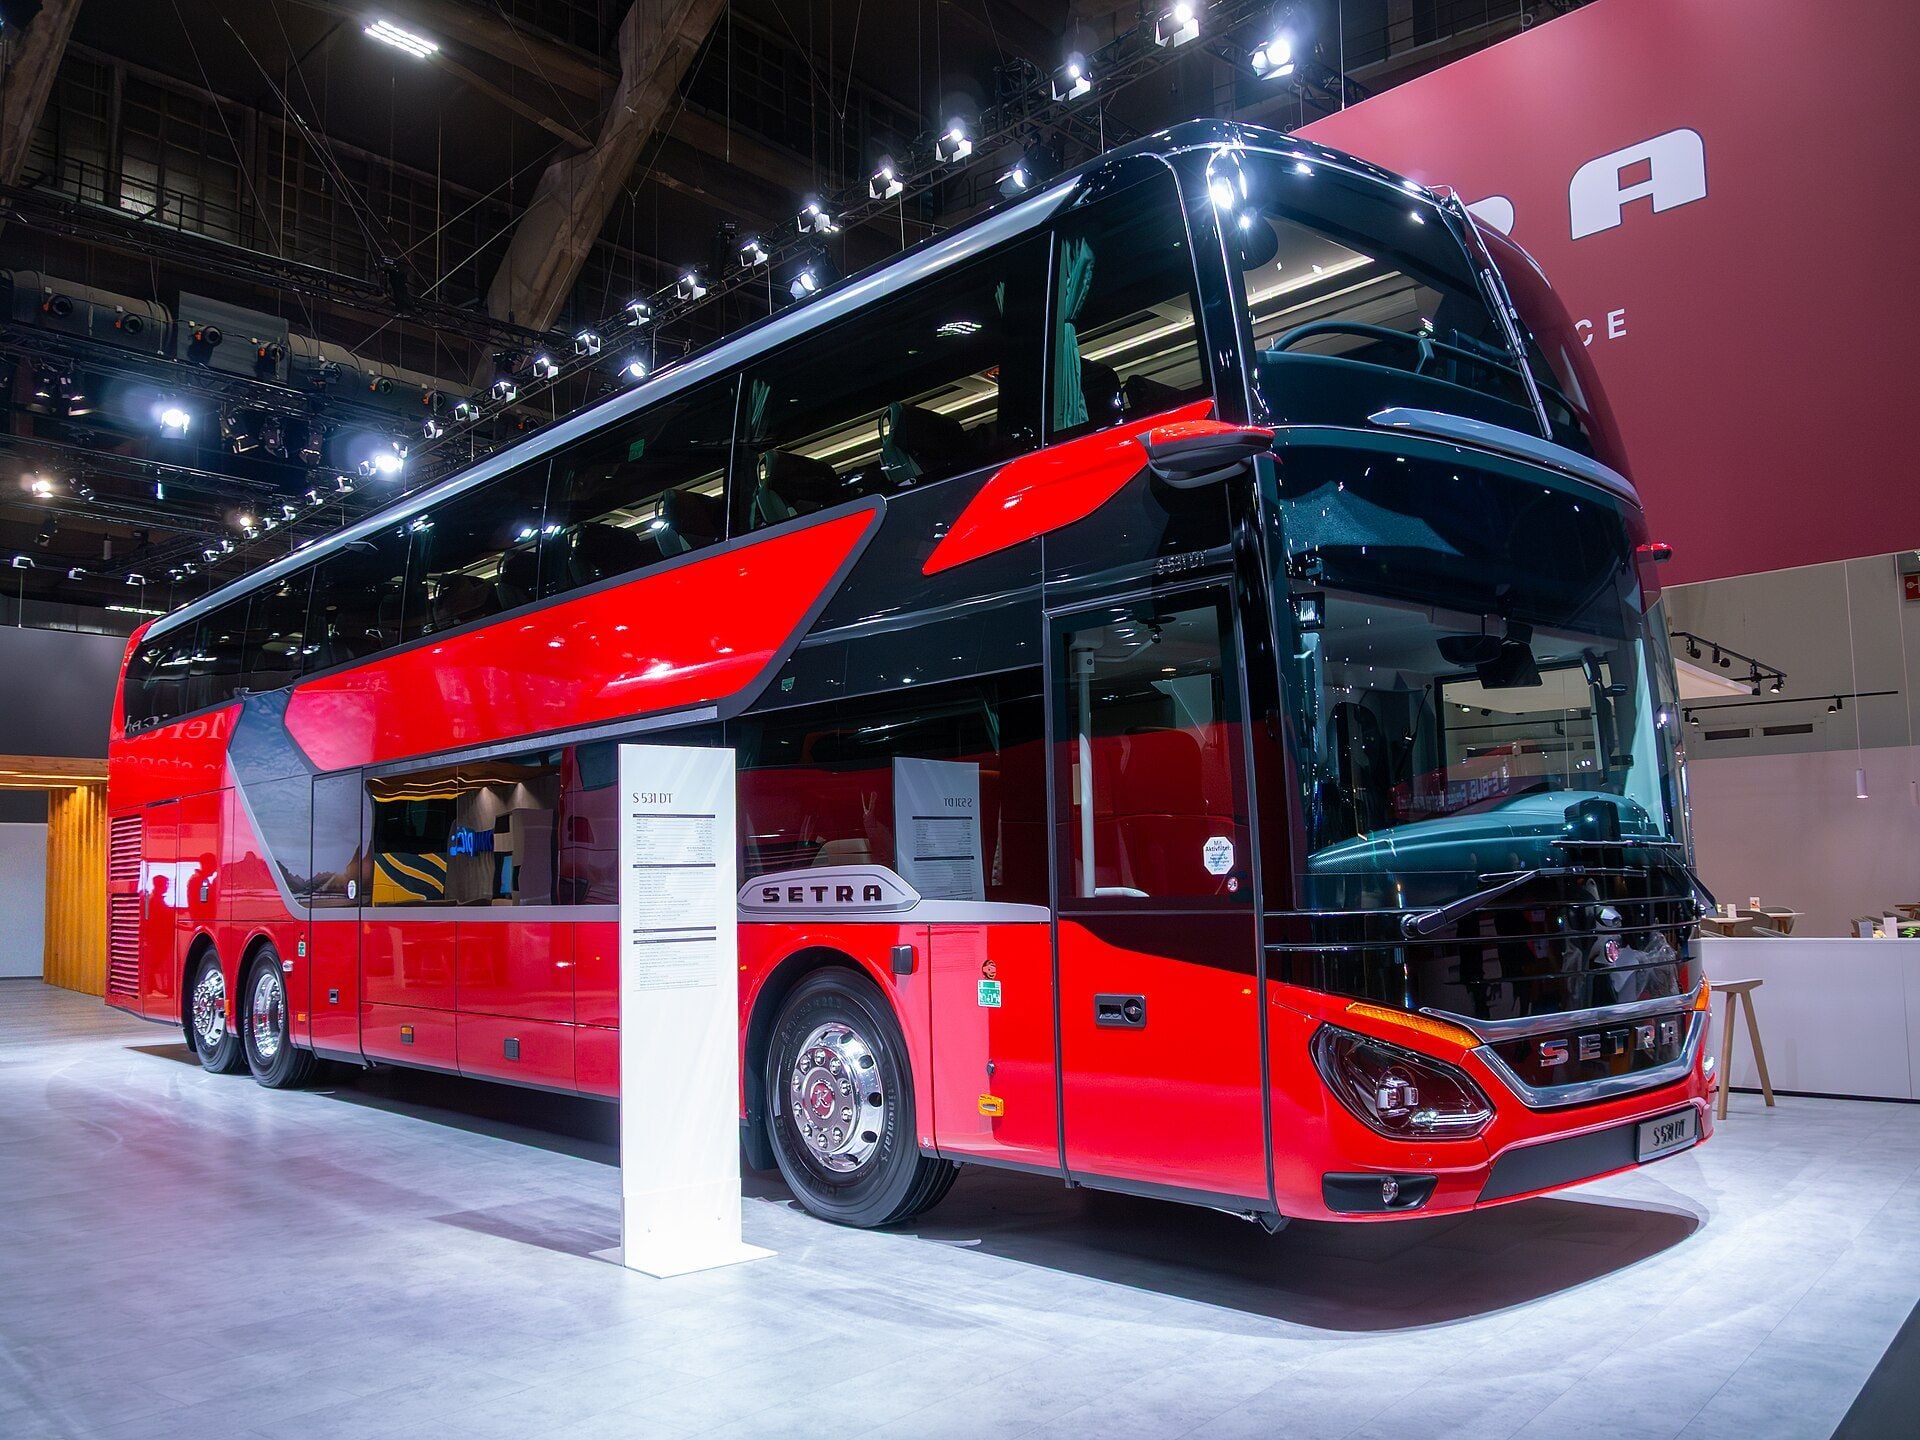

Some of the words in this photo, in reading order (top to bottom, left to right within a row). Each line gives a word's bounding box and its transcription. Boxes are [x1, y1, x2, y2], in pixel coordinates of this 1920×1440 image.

[632, 792, 640, 804] S
[641, 792, 657, 804] 531
[659, 792, 673, 804] DT
[762, 884, 882, 904] SETRA
[1539, 1020, 1678, 1067] SETRA
